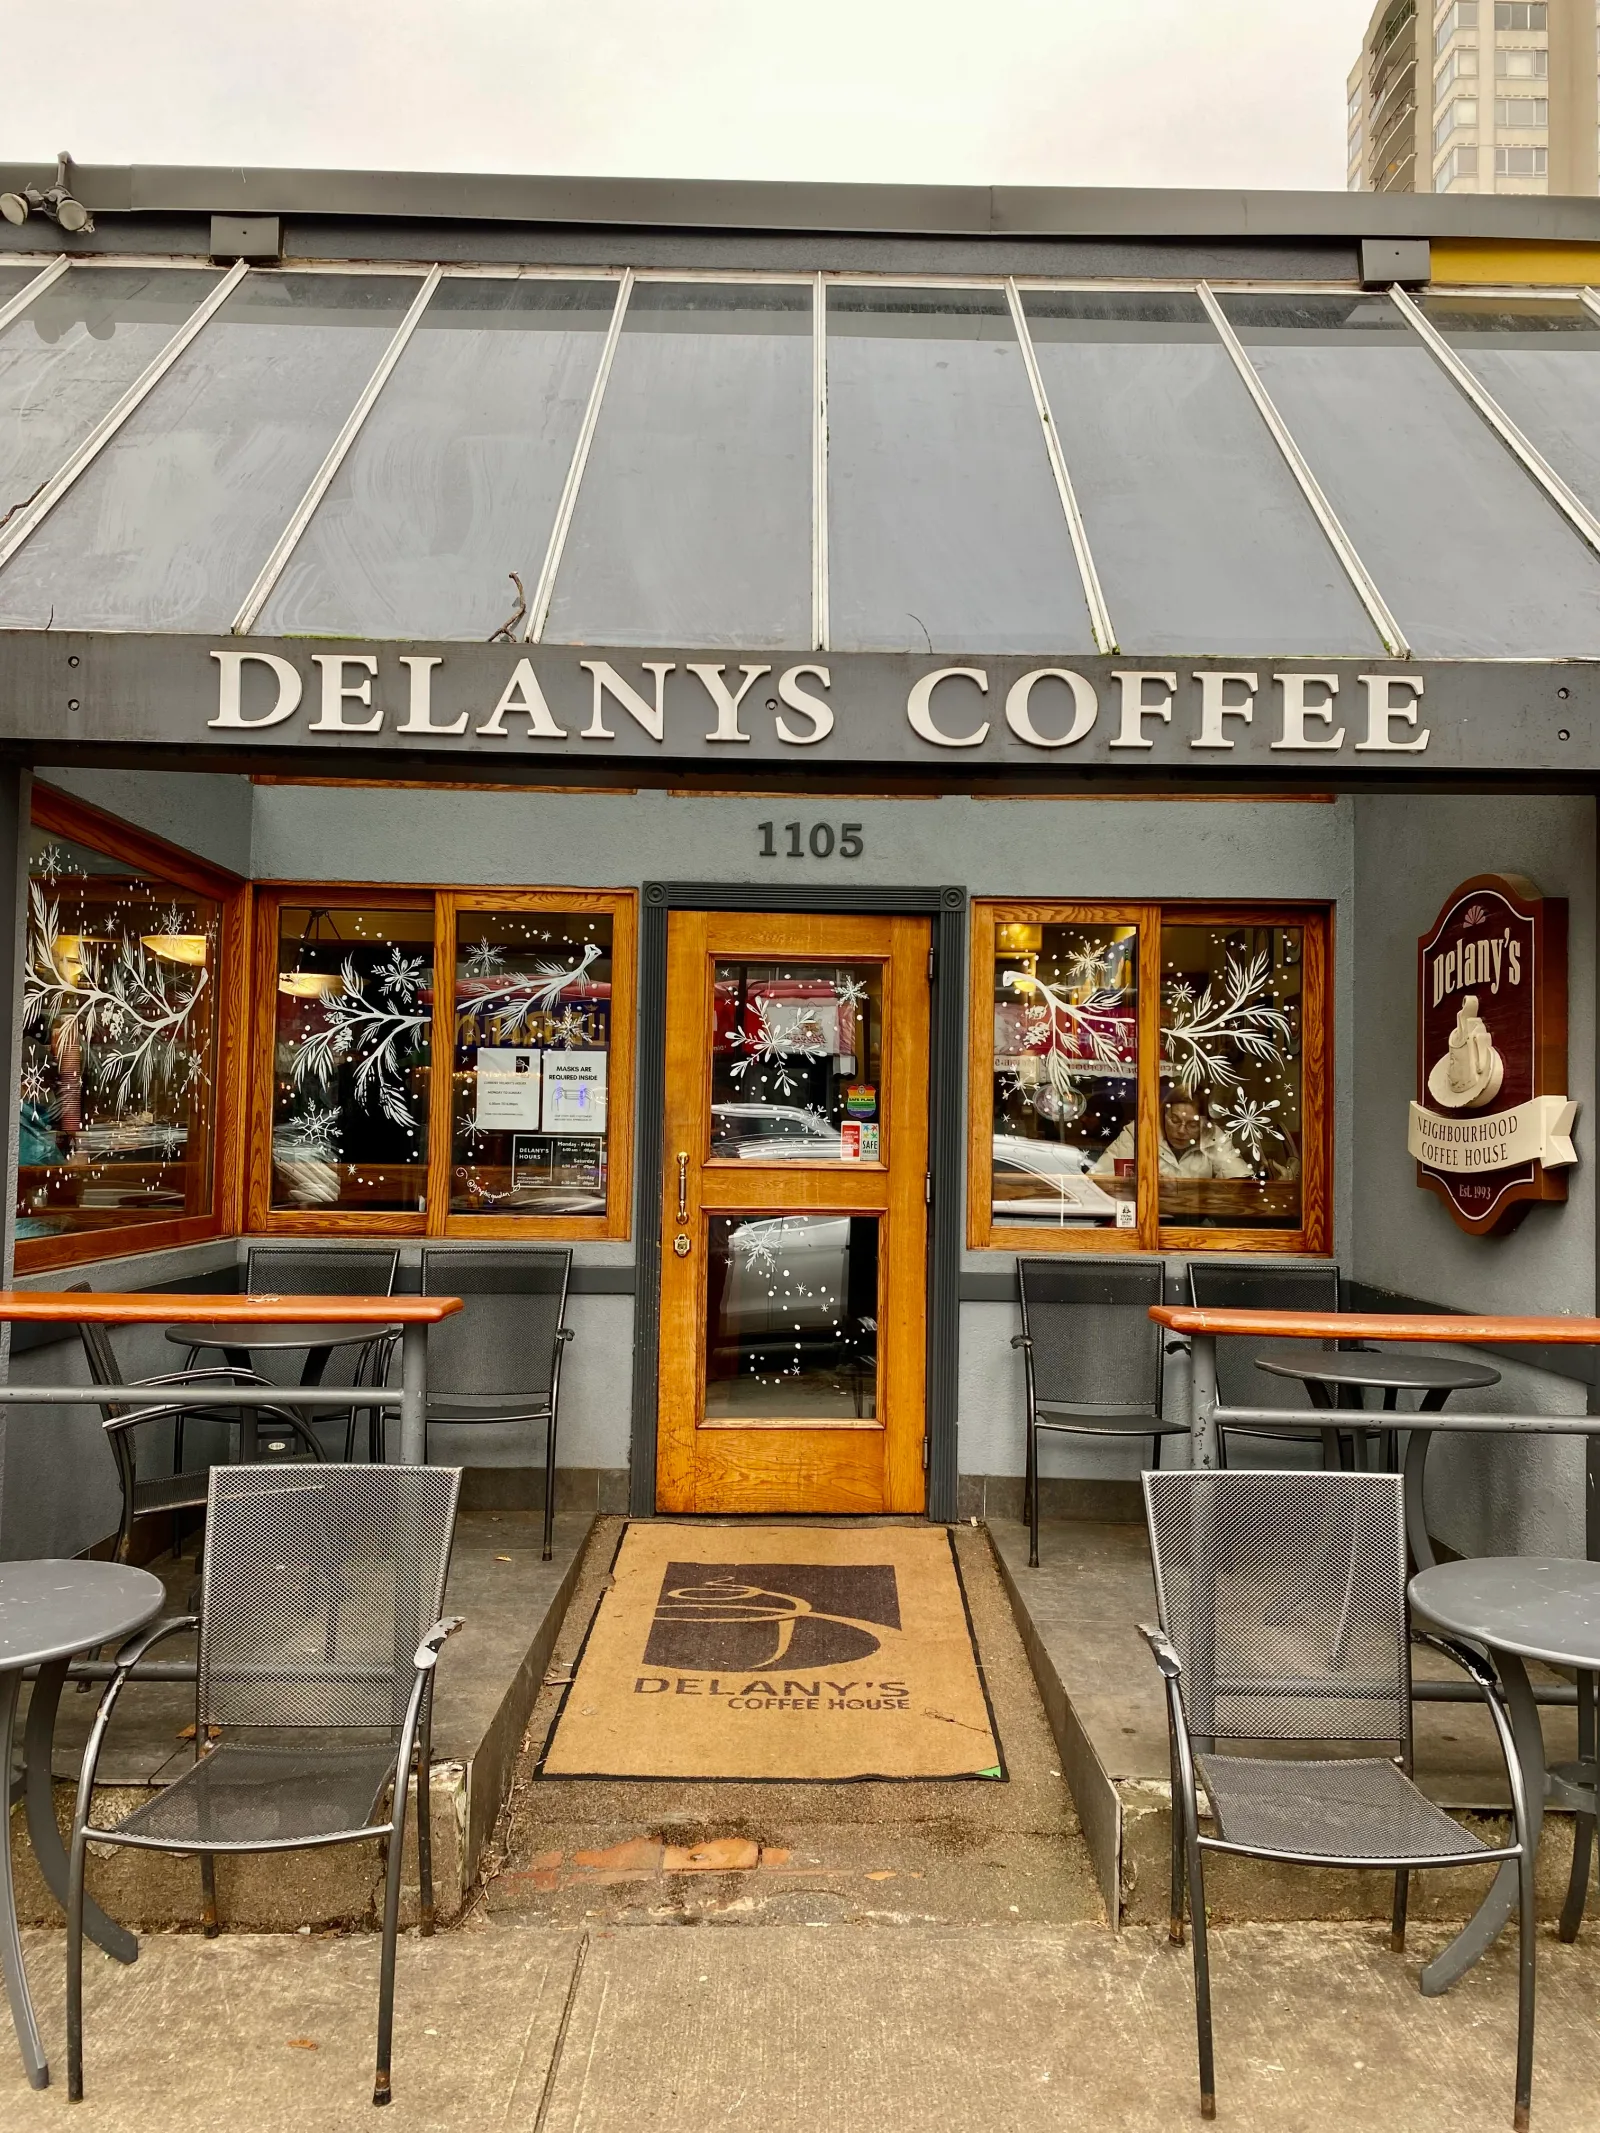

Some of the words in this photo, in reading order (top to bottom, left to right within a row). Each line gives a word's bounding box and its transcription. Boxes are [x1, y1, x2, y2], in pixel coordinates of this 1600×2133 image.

[207, 650, 836, 745] DELANYS
[907, 667, 1431, 751] COFFEE
[758, 821, 864, 858] 1105
[1432, 927, 1521, 1009] Delany's
[1416, 1115, 1518, 1143] NEIGHBOURHOOD
[862, 1140, 878, 1149] SAFE
[1421, 1141, 1459, 1166] COFFEE
[1465, 1142, 1509, 1167] HOUSE
[1459, 1184, 1473, 1198] Est.
[1473, 1186, 1491, 1200] 1993
[633, 1677, 911, 1698] DELANY'S
[727, 1697, 819, 1710] COFFEE
[828, 1698, 911, 1711] HOUSE
